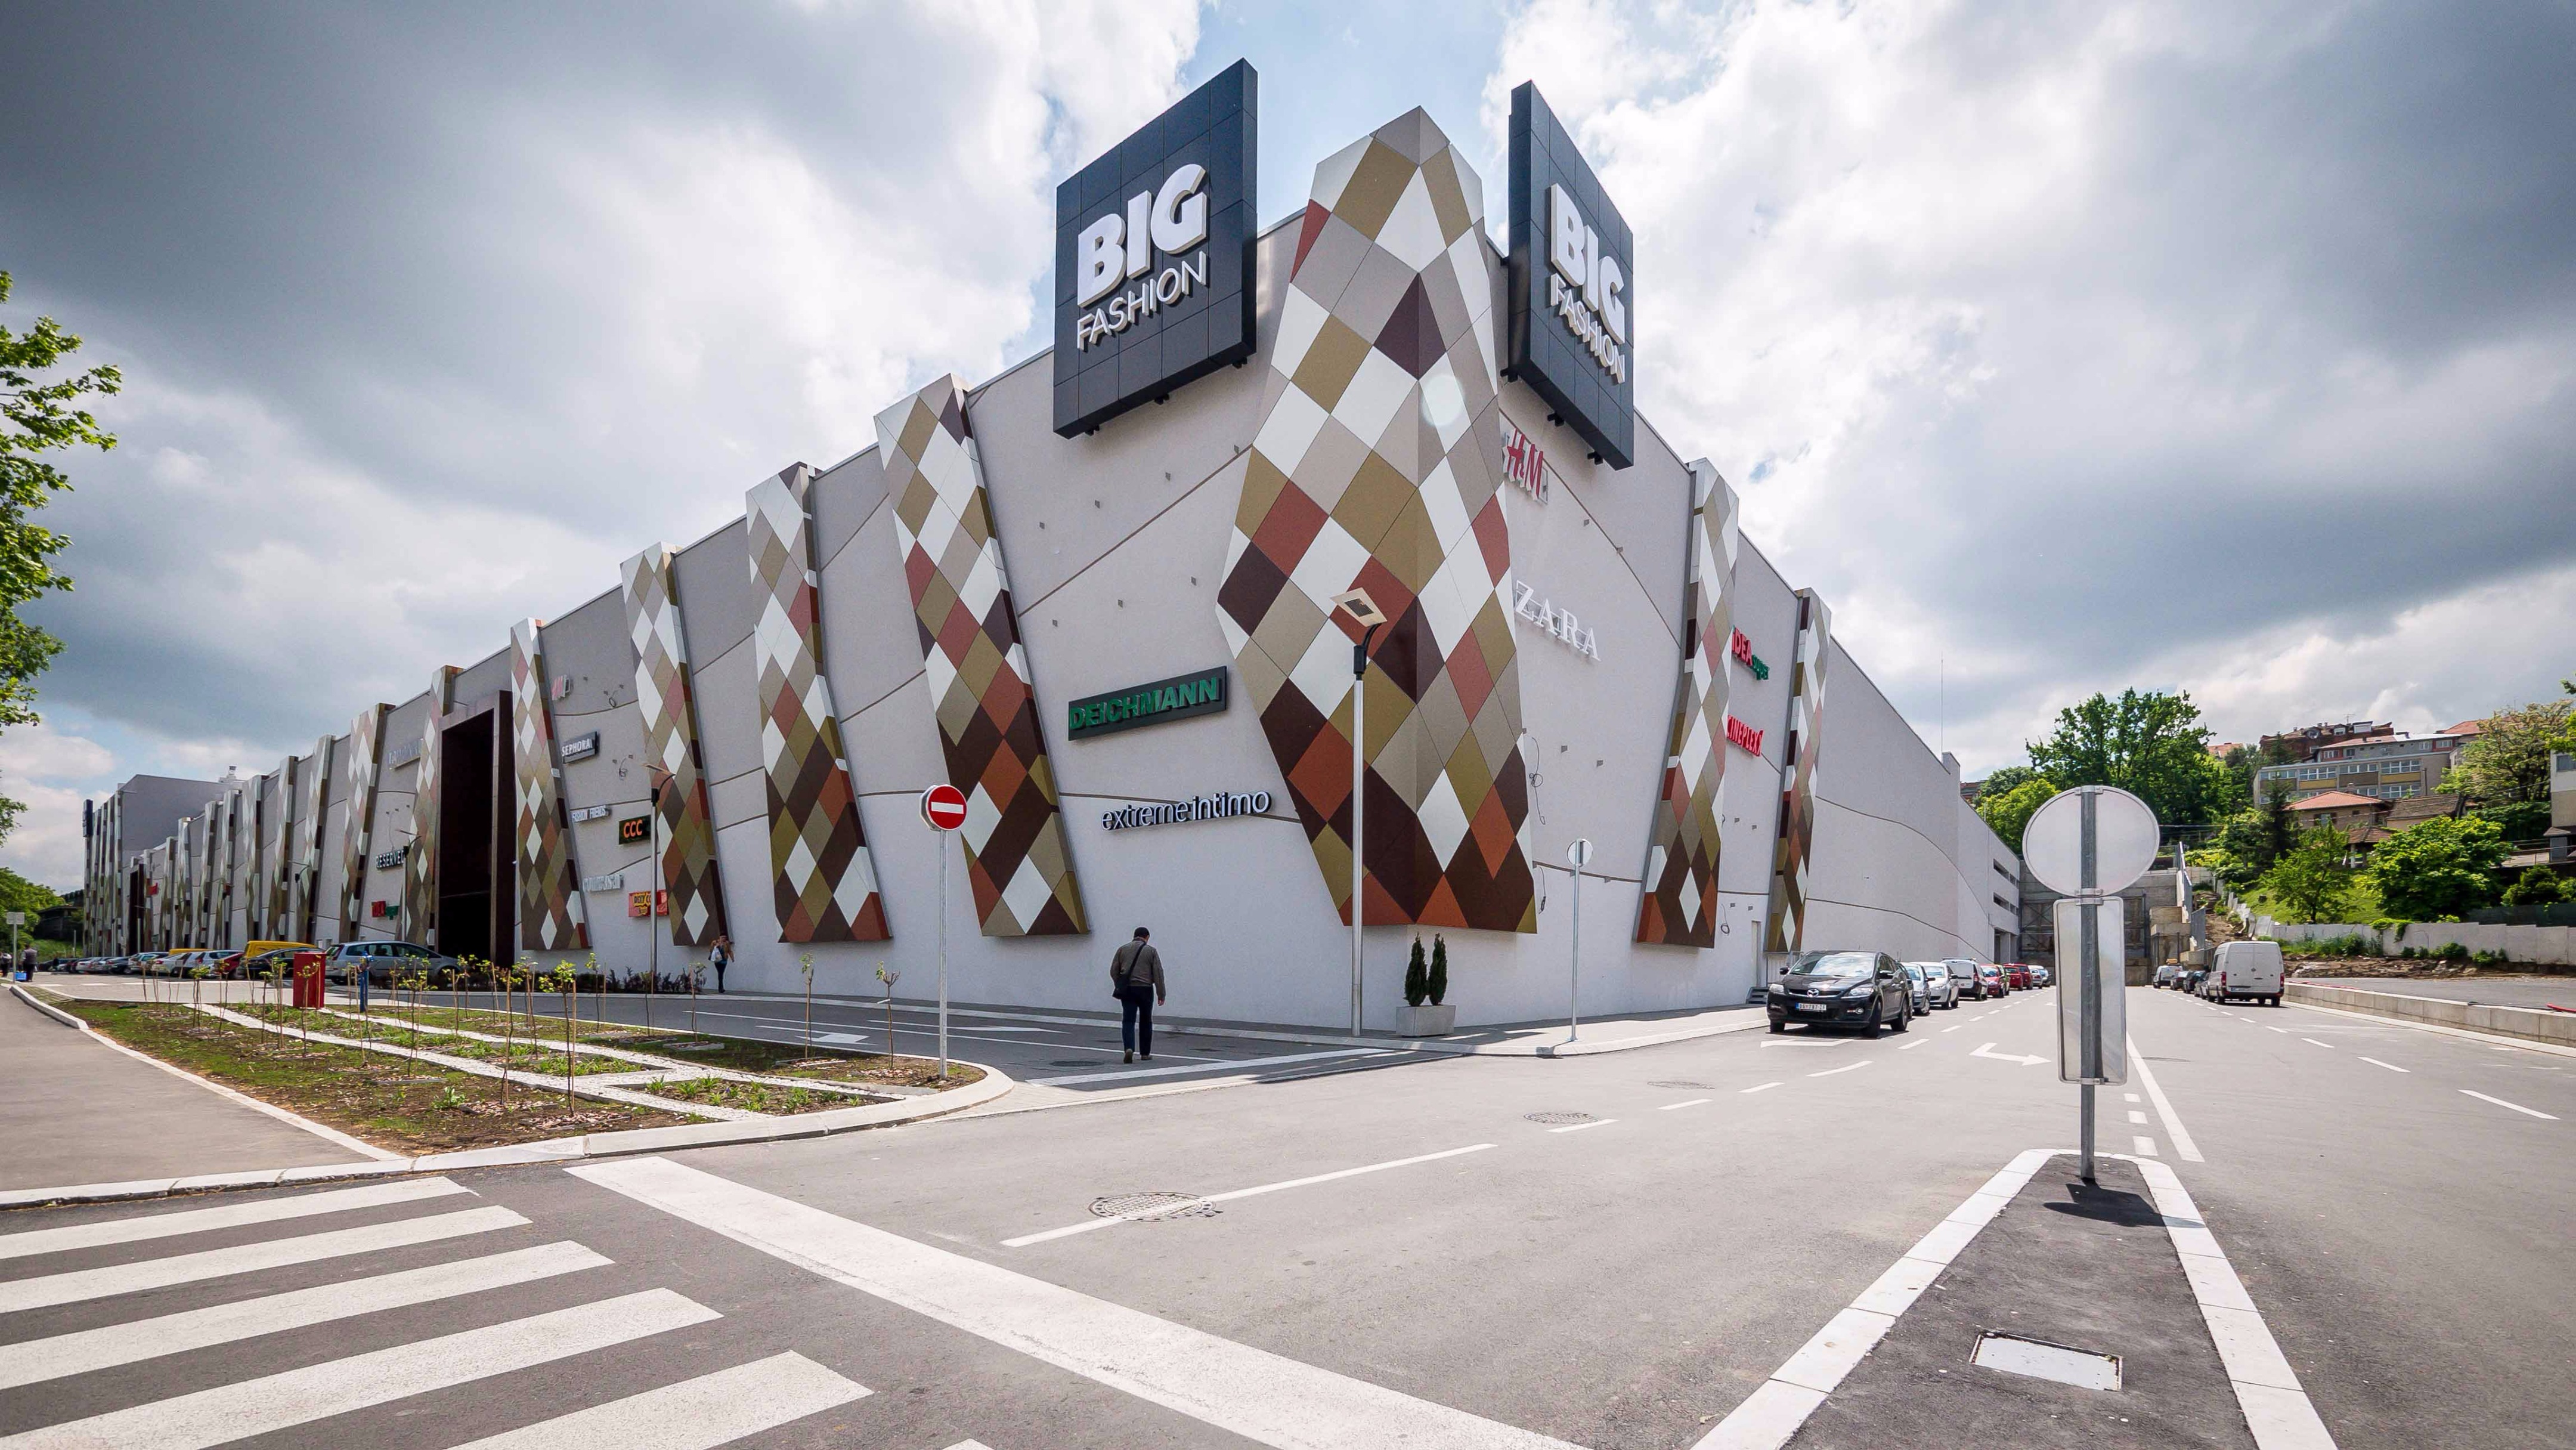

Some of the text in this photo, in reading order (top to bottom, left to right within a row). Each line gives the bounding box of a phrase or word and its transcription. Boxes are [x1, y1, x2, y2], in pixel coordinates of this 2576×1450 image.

[1077, 163, 1207, 308] BIG
[1550, 183, 1626, 345] BIG
[1076, 251, 1207, 351] FASHION
[1550, 273, 1626, 384] FASHION
[1503, 428, 1544, 500] H&M
[1515, 579, 1602, 661] ZARA
[1070, 676, 1218, 729] DEICHMANN
[561, 738, 593, 757] SEPHORA
[623, 819, 643, 838] CCC
[1101, 790, 1272, 831] extreme intimo
